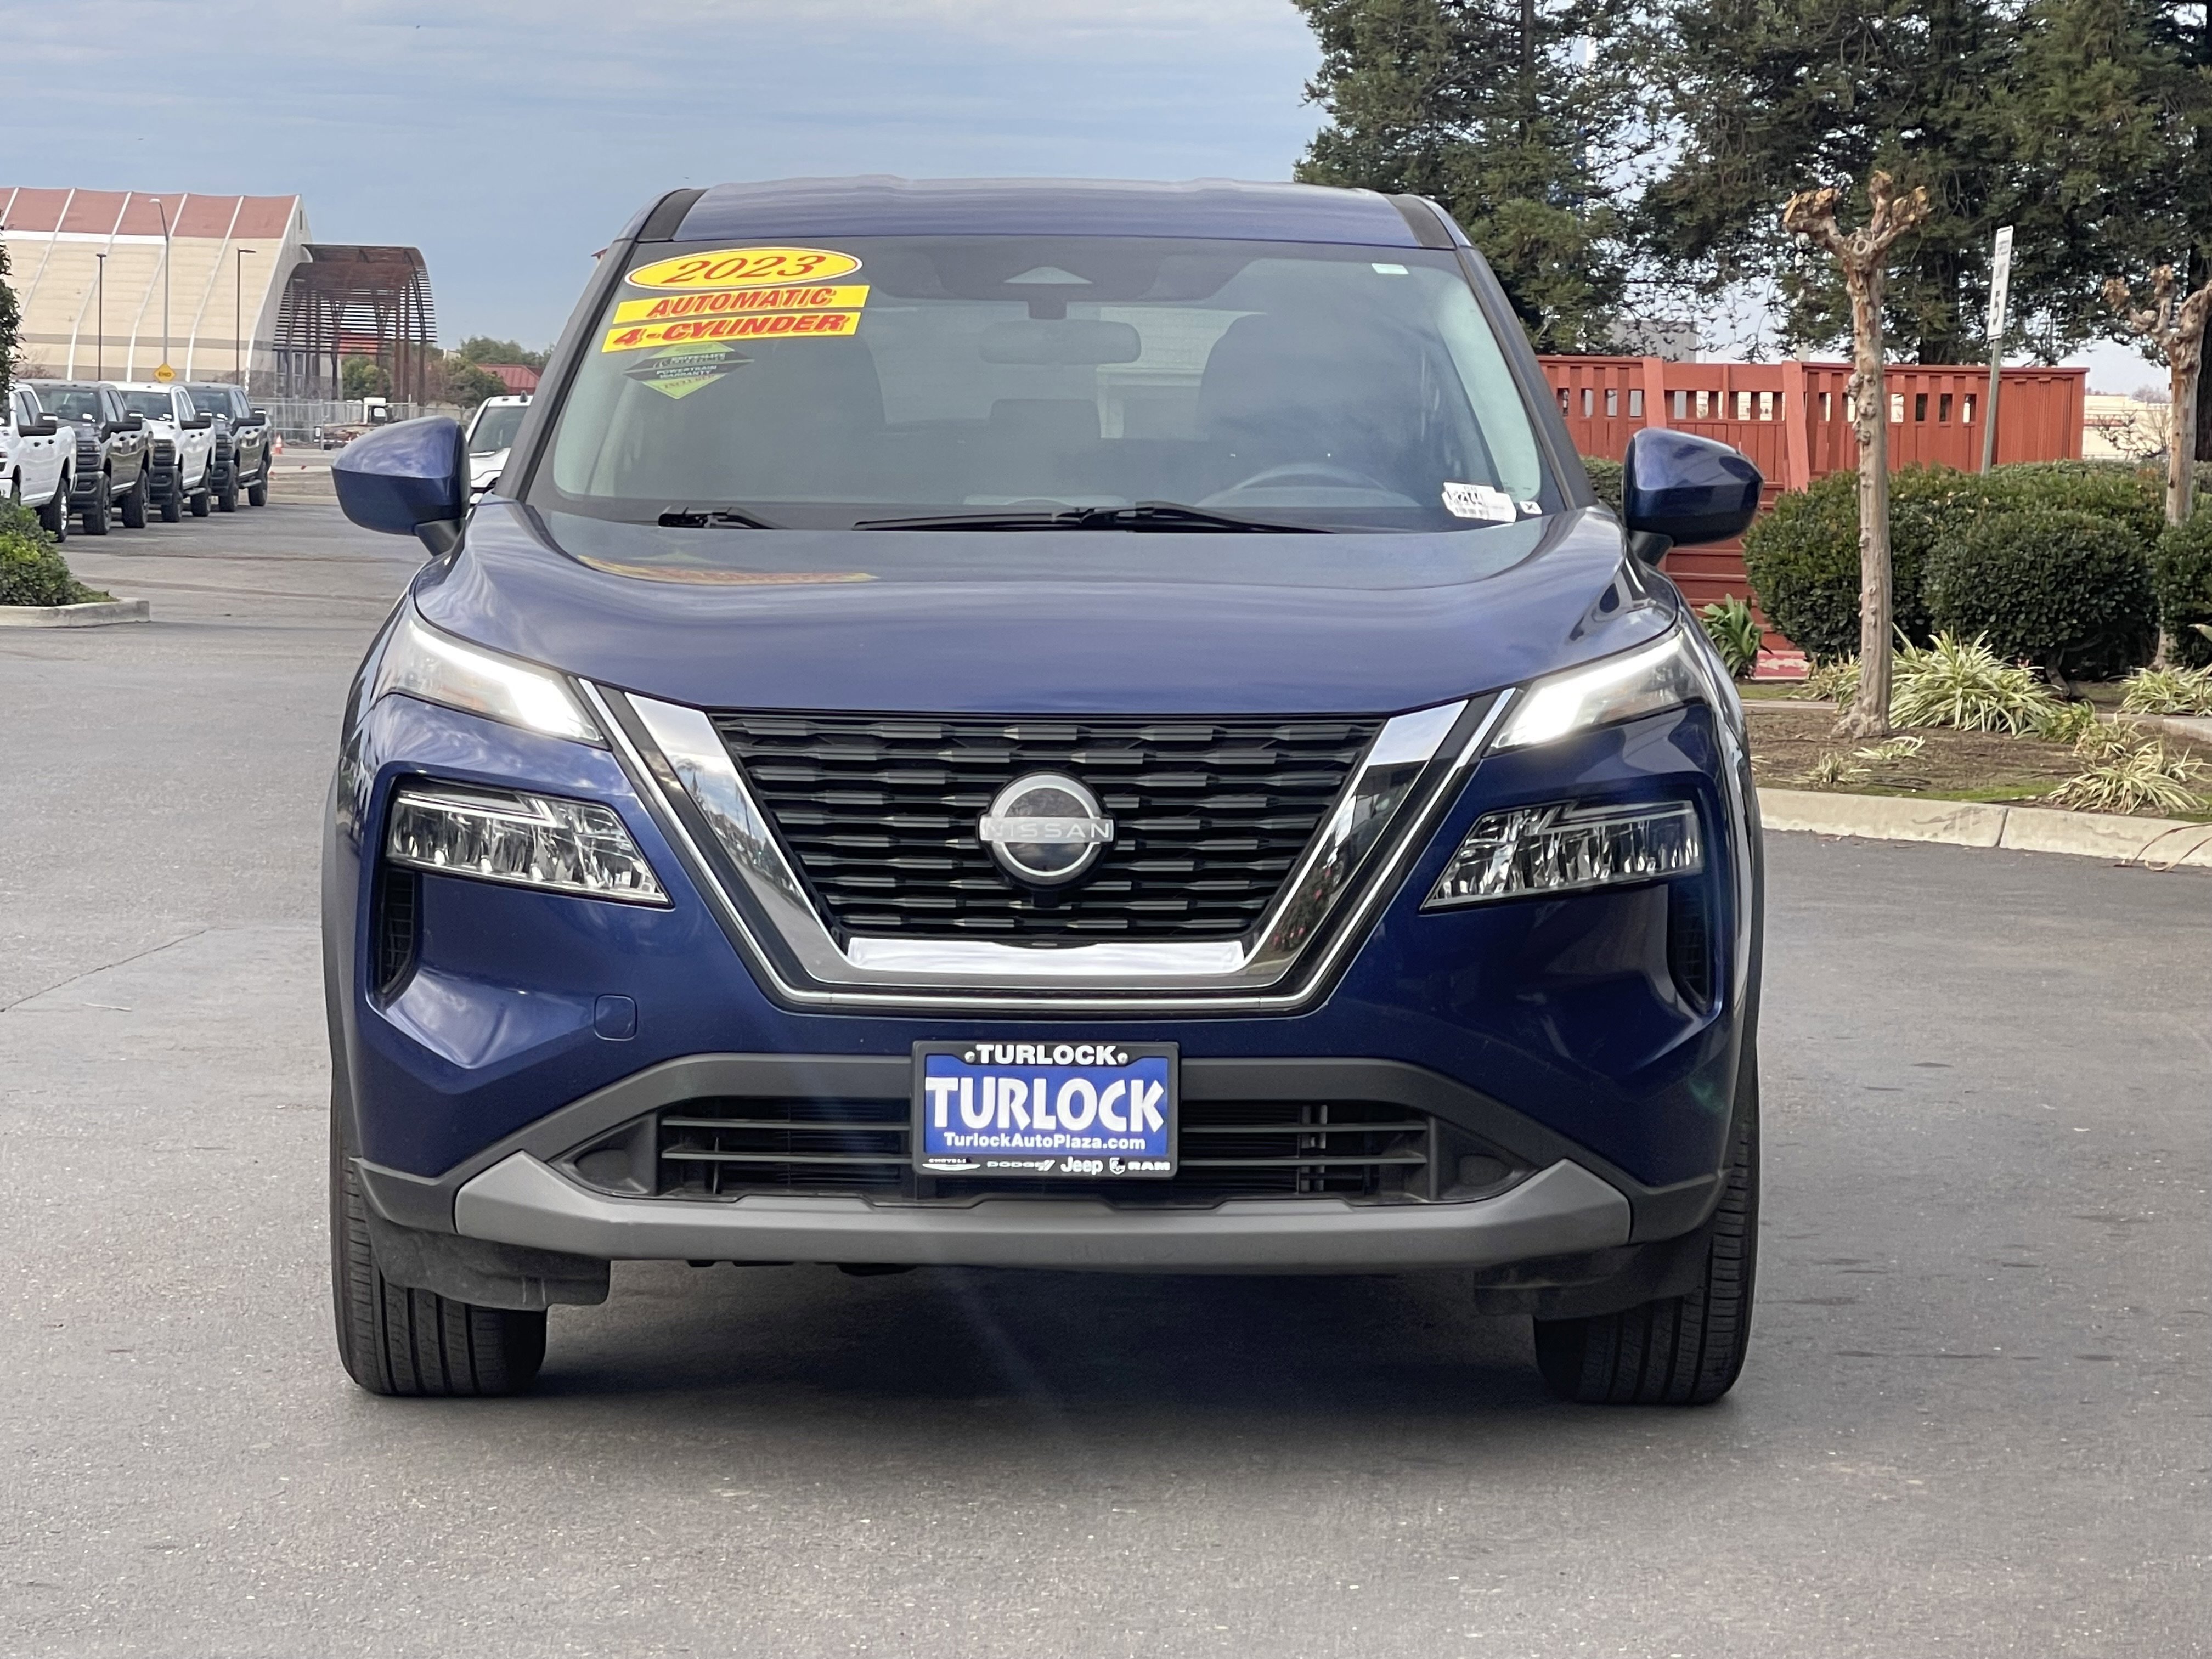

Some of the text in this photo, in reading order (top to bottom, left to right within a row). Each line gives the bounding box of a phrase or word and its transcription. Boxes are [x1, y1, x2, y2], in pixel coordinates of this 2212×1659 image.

[661, 255, 826, 284] 2023
[646, 287, 837, 318] AUTOMATIC
[613, 314, 850, 347] 4-CYLINDER
[985, 822, 1109, 838] NISSAN
[975, 1044, 1118, 1065] TURLOCK
[925, 1076, 1165, 1133] TURLOCK
[944, 1132, 1146, 1150] TurlockAutoPlaza.com
[1060, 1156, 1104, 1175] Jeep
[1128, 1161, 1171, 1171] RAM
